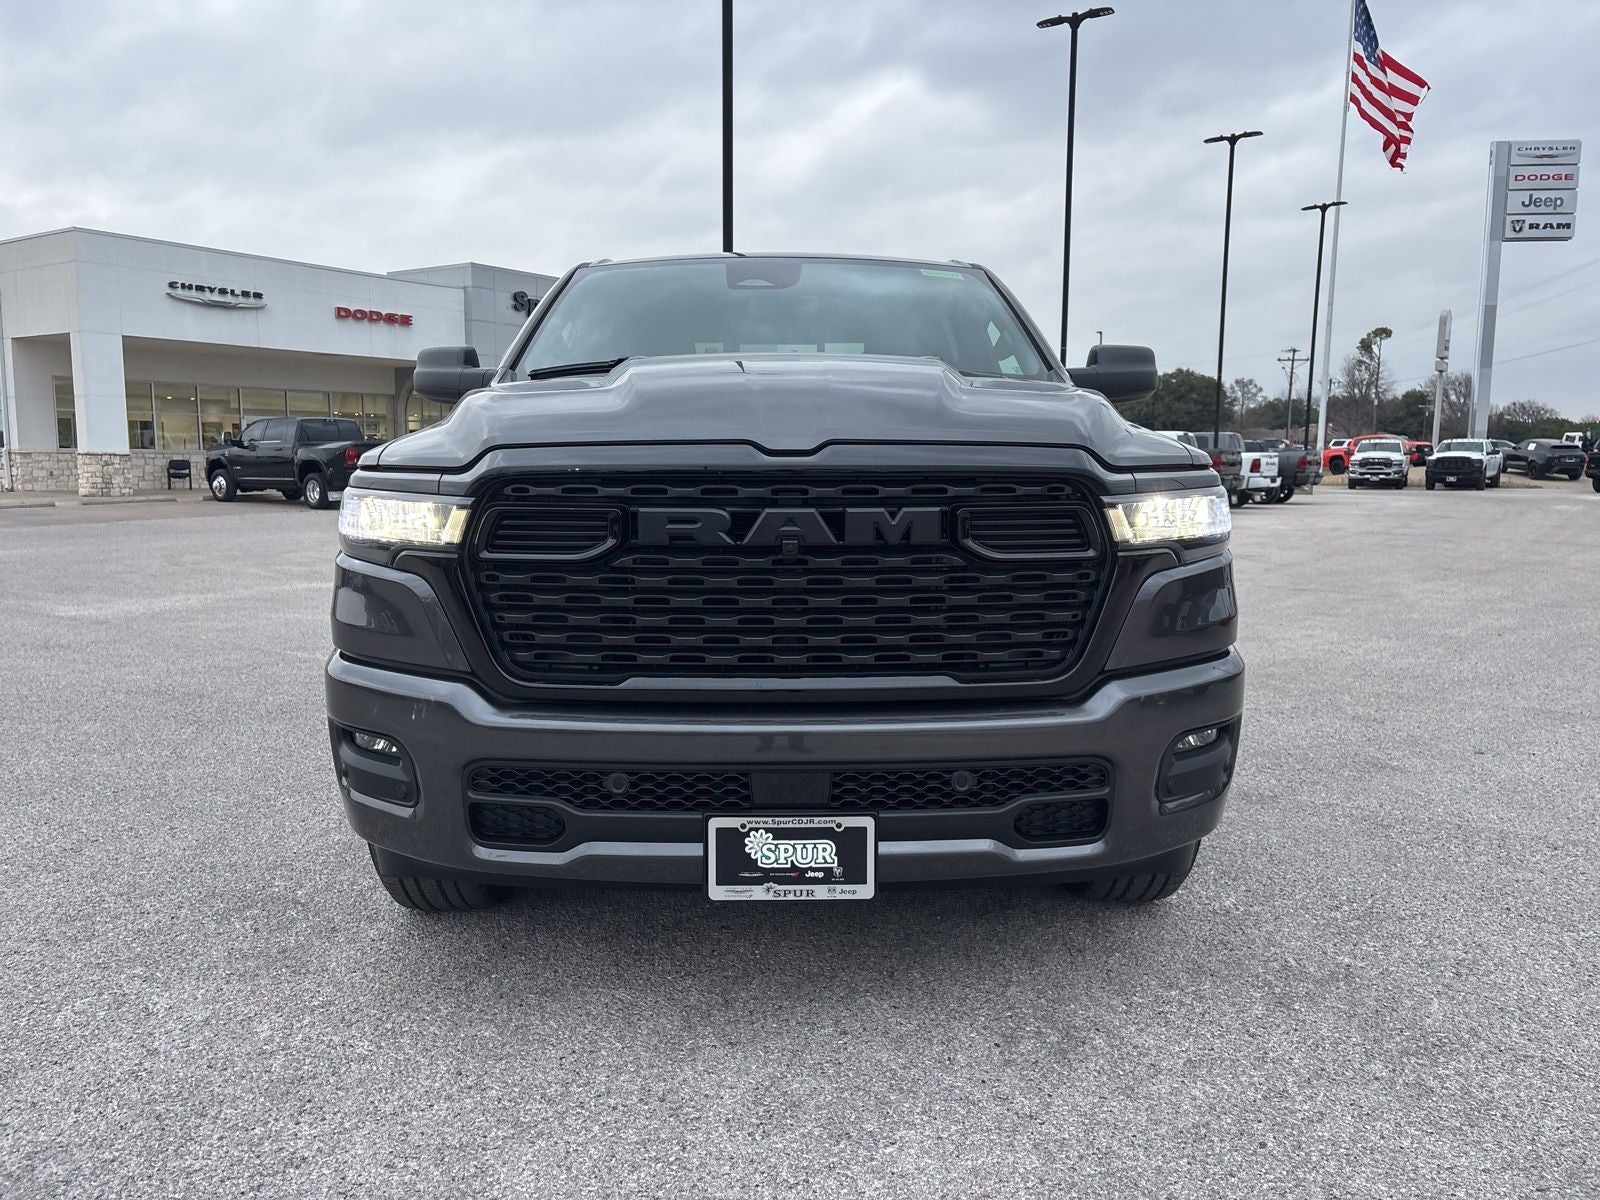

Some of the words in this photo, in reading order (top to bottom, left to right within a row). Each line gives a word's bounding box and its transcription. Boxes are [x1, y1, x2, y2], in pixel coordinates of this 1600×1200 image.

[1514, 173, 1575, 182] DODGE
[1521, 193, 1564, 211] Jeep
[1528, 222, 1572, 230] RAM
[168, 281, 264, 299] CHRYSLER
[335, 306, 413, 326] DODGE
[638, 507, 943, 546] RAM
[746, 818, 837, 826] www.SpurCDJR.com
[760, 842, 836, 866] SPUR
[805, 870, 824, 879] Jeep
[773, 888, 816, 898] SPUR
[838, 888, 858, 896] Jeep
